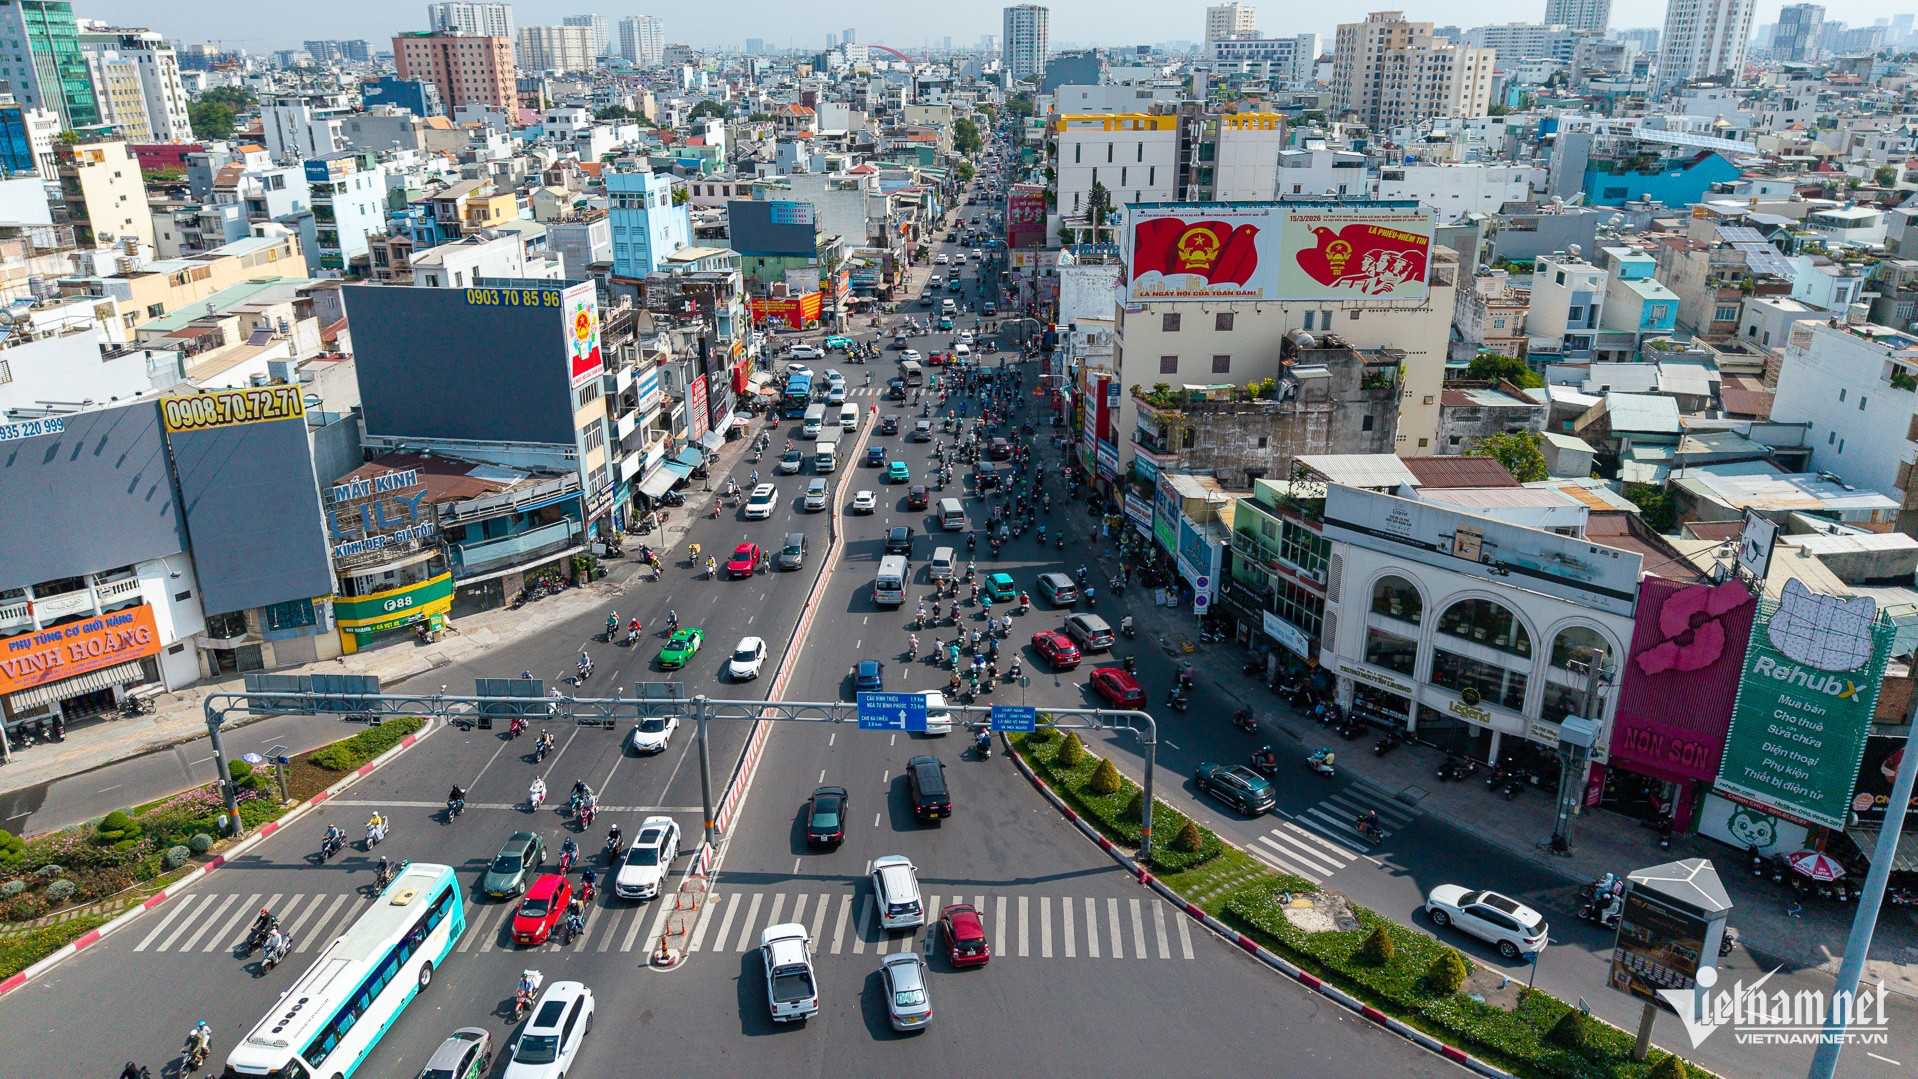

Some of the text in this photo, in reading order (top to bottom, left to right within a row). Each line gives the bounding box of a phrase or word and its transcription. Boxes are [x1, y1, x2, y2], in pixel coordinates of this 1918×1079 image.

[466, 289, 499, 304] 0903
[502, 290, 519, 305] 70
[522, 290, 539, 306] 85
[543, 291, 560, 307] 96
[166, 387, 300, 428] 0908.70.72.71
[22, 421, 42, 436] 220
[44, 418, 64, 432] 999
[333, 469, 418, 502] MẮT KÍNH
[328, 489, 428, 538] LILY
[334, 540, 363, 558] KÍNH
[365, 535, 386, 551] ĐẸP
[395, 525, 414, 543] GIÁ
[413, 520, 434, 538] TỐT
[8, 612, 133, 652] PHỤ TÙNG CƠ GIỚI NẶNG
[0, 648, 64, 679] VINH
[68, 625, 151, 662] HOÀNG
[1340, 665, 1361, 677] TRUNG
[1387, 680, 1412, 694] LEGEND
[1448, 701, 1491, 723] Legend
[1778, 694, 1826, 716] Mua bán
[1774, 710, 1824, 732] Cho thuê
[1624, 726, 1664, 758] NÓN
[1669, 738, 1709, 770] SƠN
[1768, 725, 1822, 748] Sửa chữa
[1762, 742, 1820, 766] Điện thoại
[1744, 767, 1824, 800] Thiết bị điện tử
[1762, 758, 1809, 780] Phụ kiện
